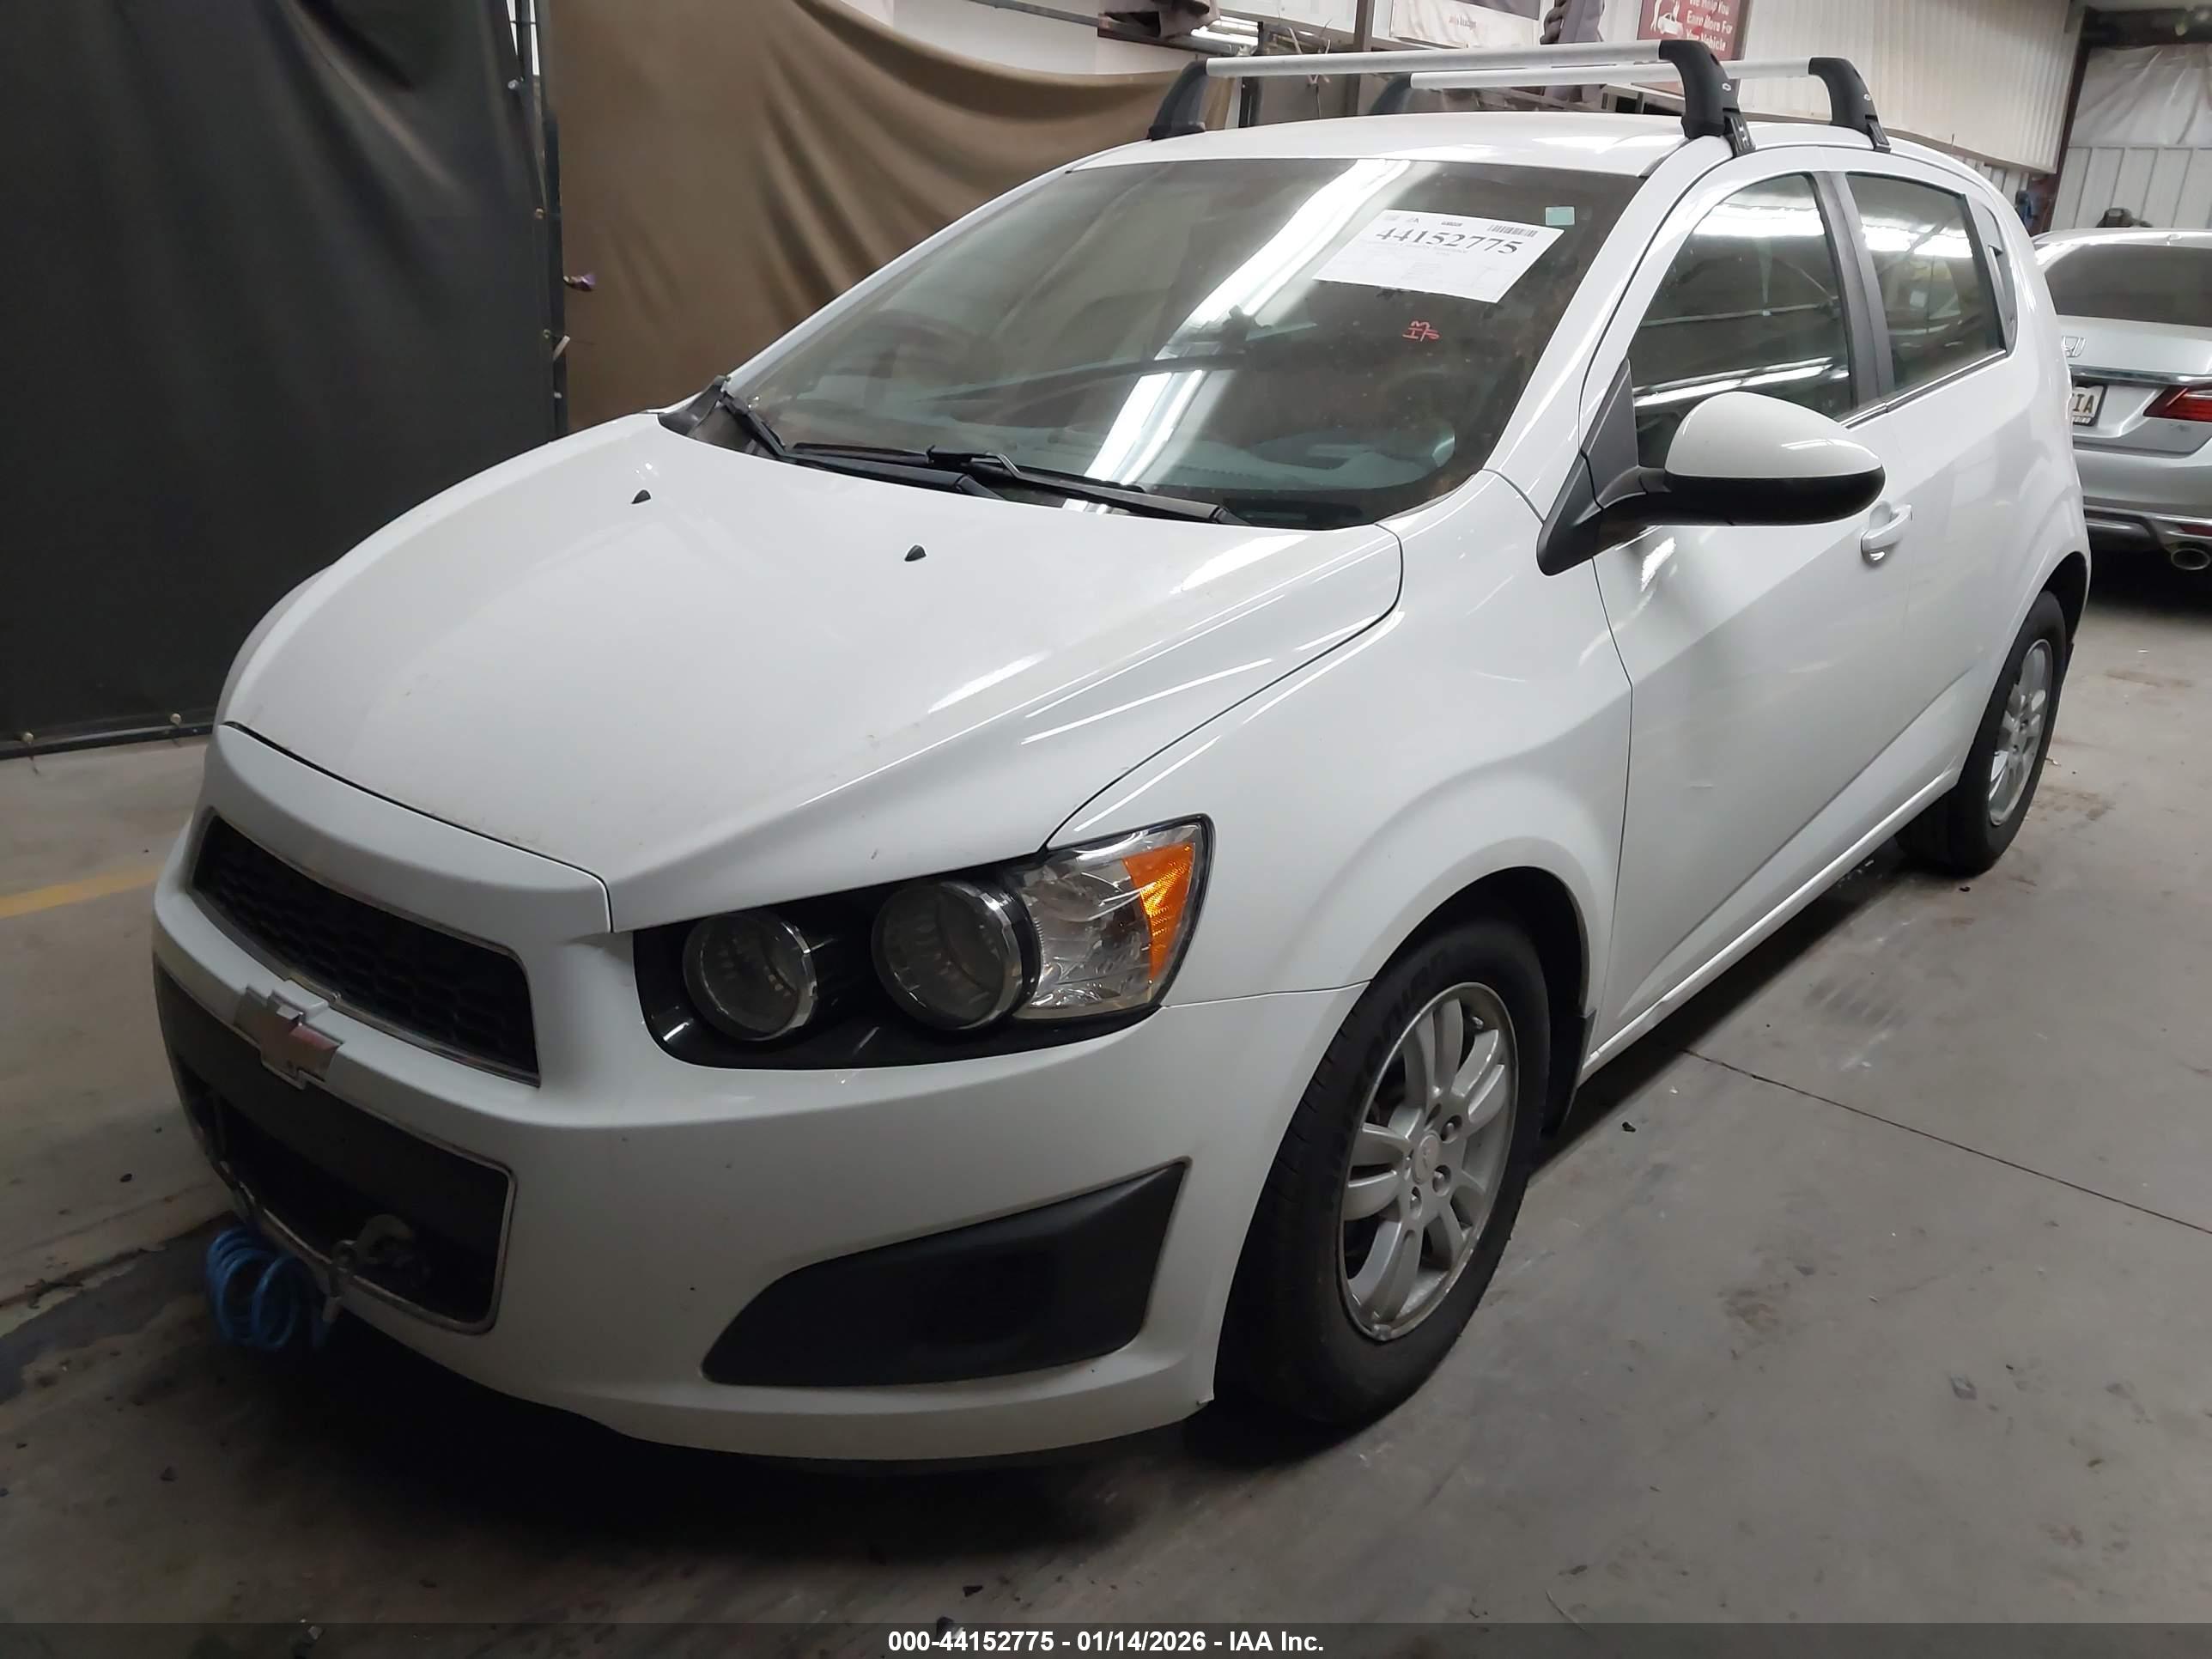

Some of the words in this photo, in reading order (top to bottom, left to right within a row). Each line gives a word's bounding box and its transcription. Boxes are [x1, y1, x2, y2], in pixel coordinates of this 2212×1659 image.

[1686, 9, 1704, 26] Earn
[1704, 15, 1721, 32] More
[1722, 21, 1733, 34] For
[1376, 228, 1522, 254] 44152775
